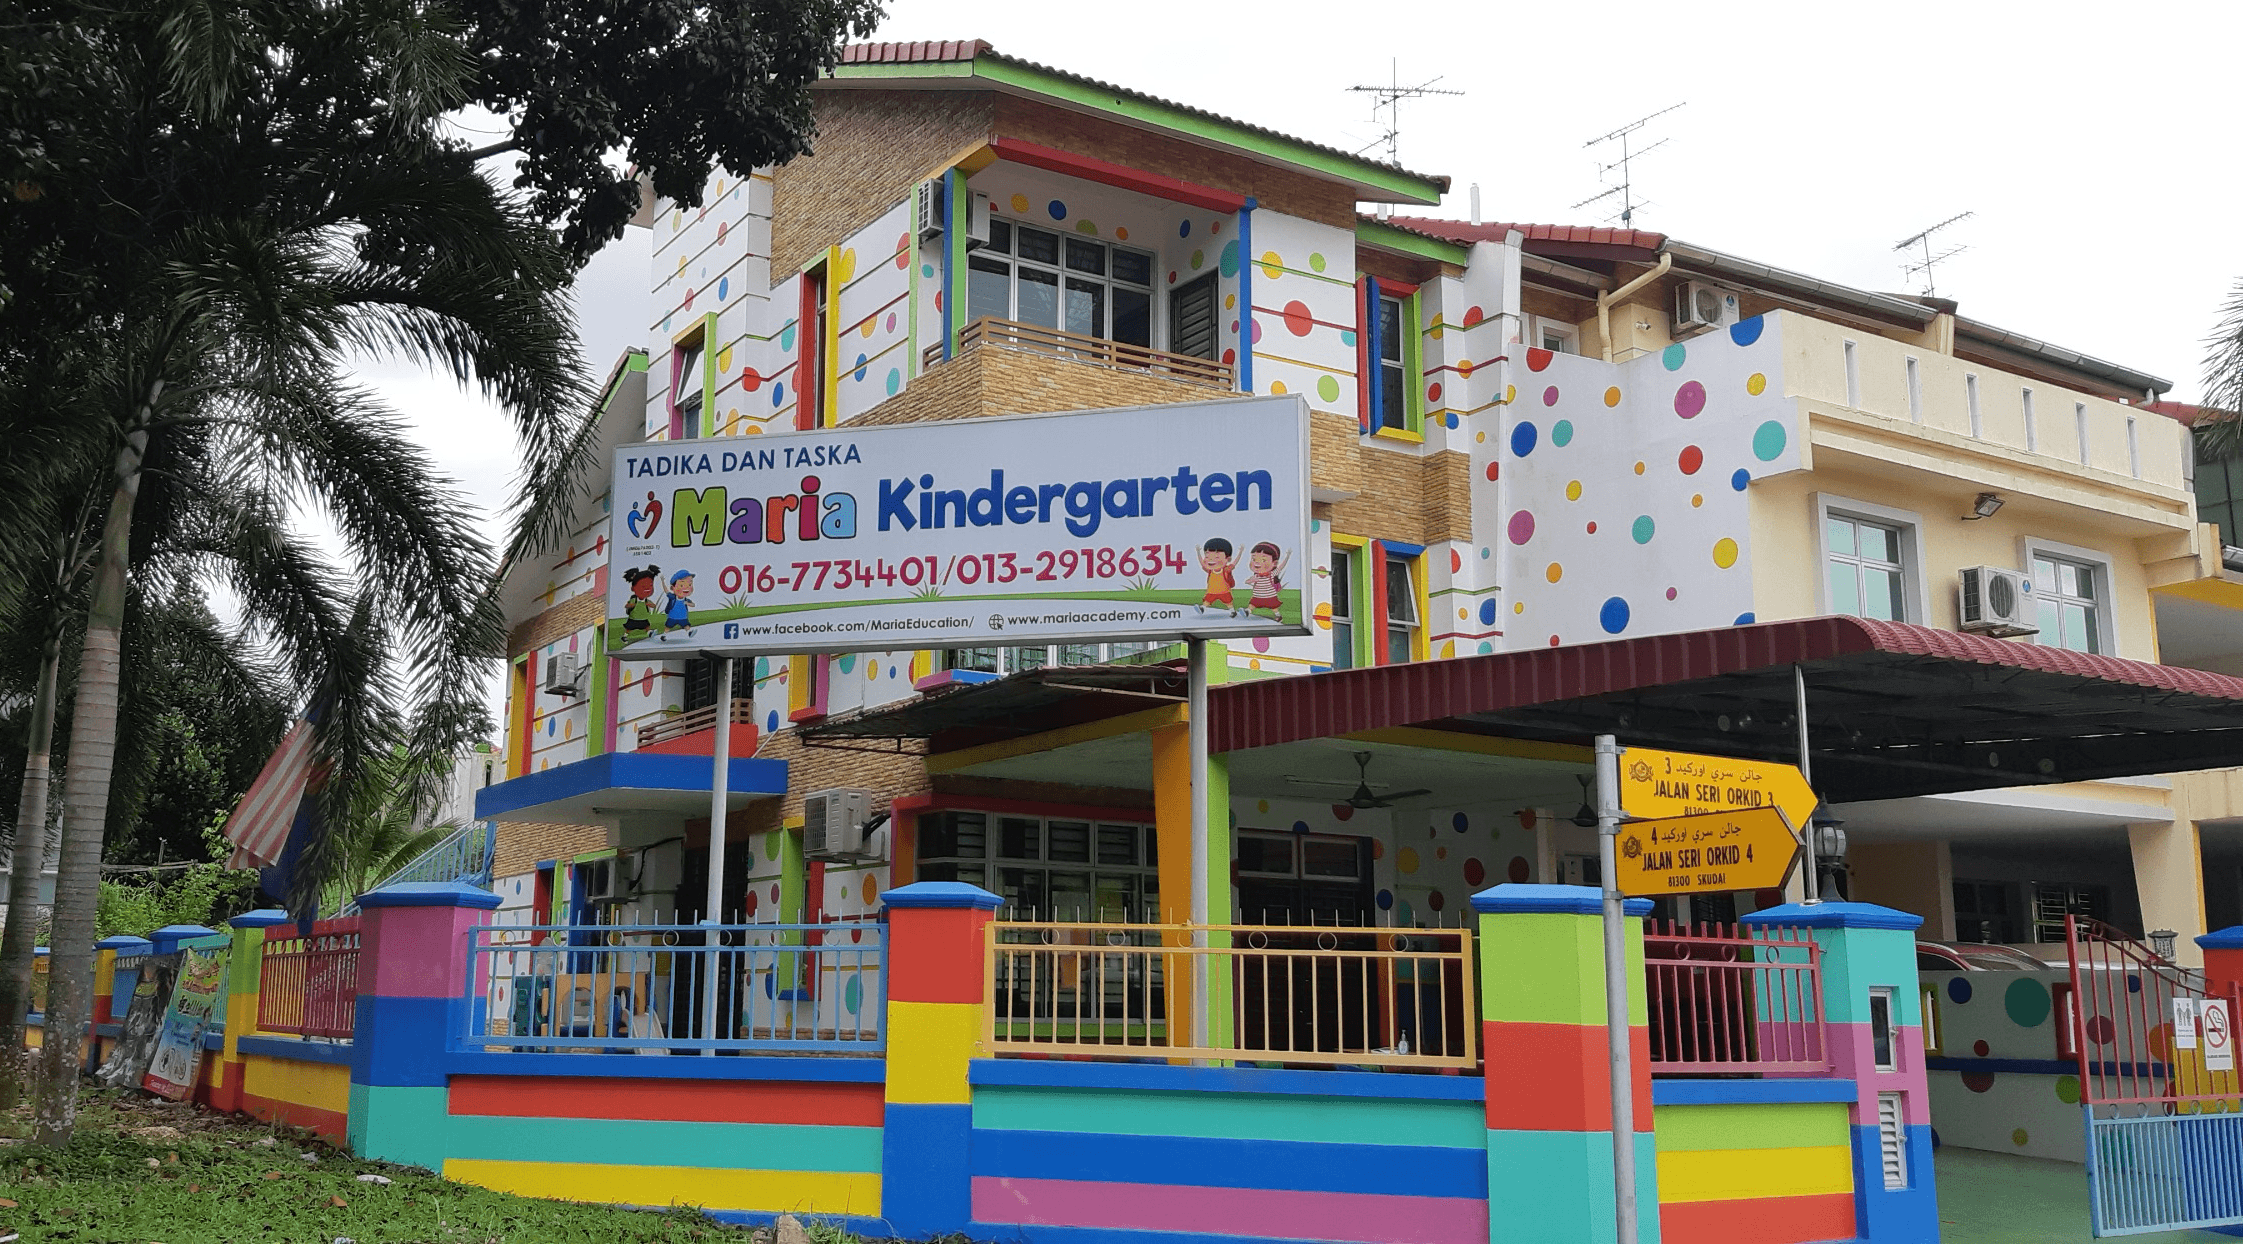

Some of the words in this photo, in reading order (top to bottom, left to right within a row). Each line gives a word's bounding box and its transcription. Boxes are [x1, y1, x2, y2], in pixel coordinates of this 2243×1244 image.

[627, 453, 713, 479] TADIKA
[721, 449, 776, 473] DAN
[783, 443, 862, 468] TASKA
[670, 474, 858, 549] Maria
[877, 465, 1273, 539] Kindergarten
[718, 543, 1188, 595] 016-7734401/013-2918634
[742, 615, 975, 636] www.facebook.com/MariaEducation/
[1007, 607, 1181, 626] www.mariaacademy.com
[1665, 757, 1671, 774] 3
[1653, 779, 1690, 800] JALAN
[1695, 783, 1721, 803] SERI
[1726, 786, 1762, 807] ORKID
[1651, 827, 1658, 845] 4
[1642, 850, 1673, 872] JALAN
[1678, 847, 1701, 869] SERI
[1706, 844, 1741, 867] ORKID
[1746, 844, 1753, 863] 4
[1667, 875, 1691, 887] 81300
[1697, 872, 1727, 886] SKUDAI
